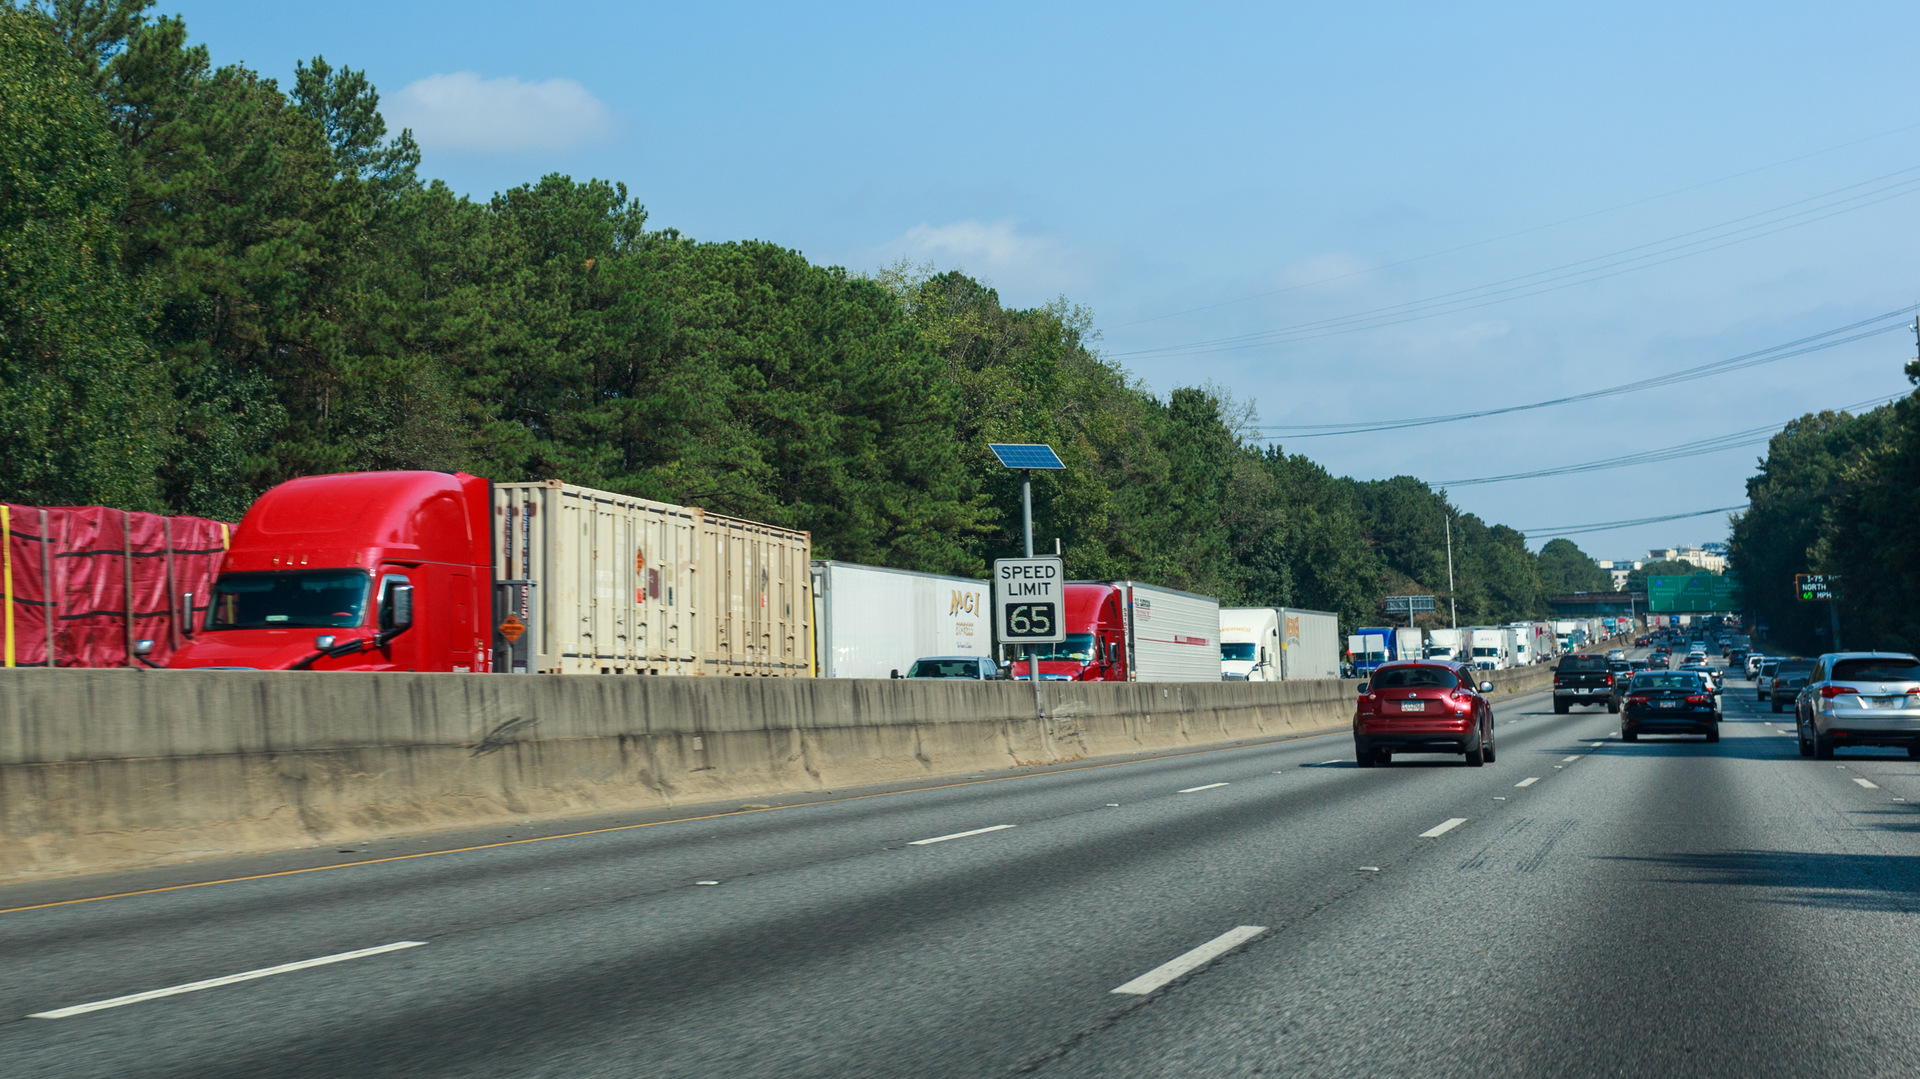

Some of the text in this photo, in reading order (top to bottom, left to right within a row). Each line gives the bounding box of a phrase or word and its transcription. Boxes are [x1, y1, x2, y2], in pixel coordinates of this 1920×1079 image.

[1001, 566, 1056, 579] SPEED
[1008, 582, 1051, 596] LIMIT
[949, 590, 980, 617] MCI
[1010, 606, 1050, 633] 65
